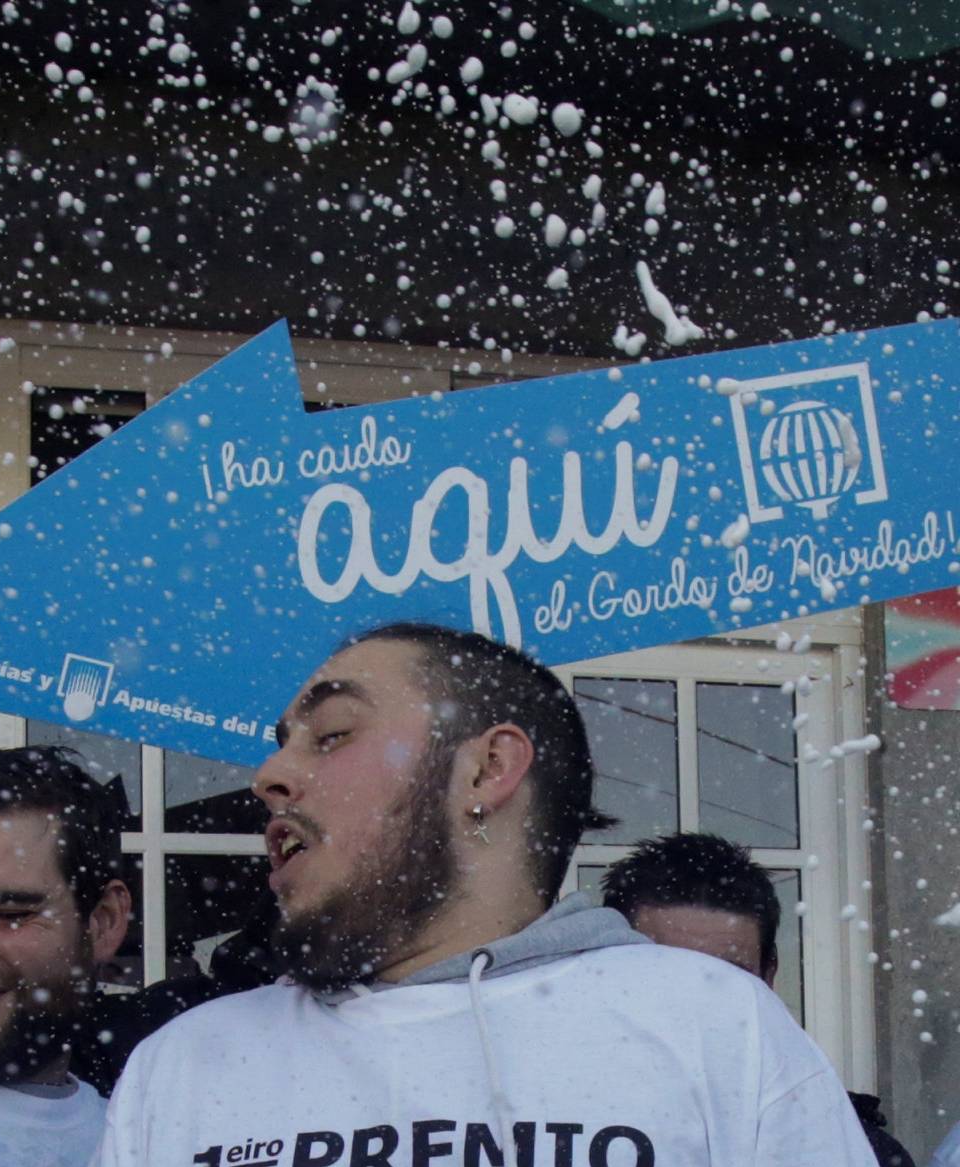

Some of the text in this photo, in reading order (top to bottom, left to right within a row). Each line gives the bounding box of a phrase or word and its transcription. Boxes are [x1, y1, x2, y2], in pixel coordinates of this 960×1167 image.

[297, 392, 679, 652] aquí
[533, 579, 573, 635] el
[587, 557, 718, 621] Gordo
[727, 545, 775, 597] de
[39, 673, 55, 691] y
[111, 688, 216, 728] Apuestas
[222, 712, 258, 738] del
